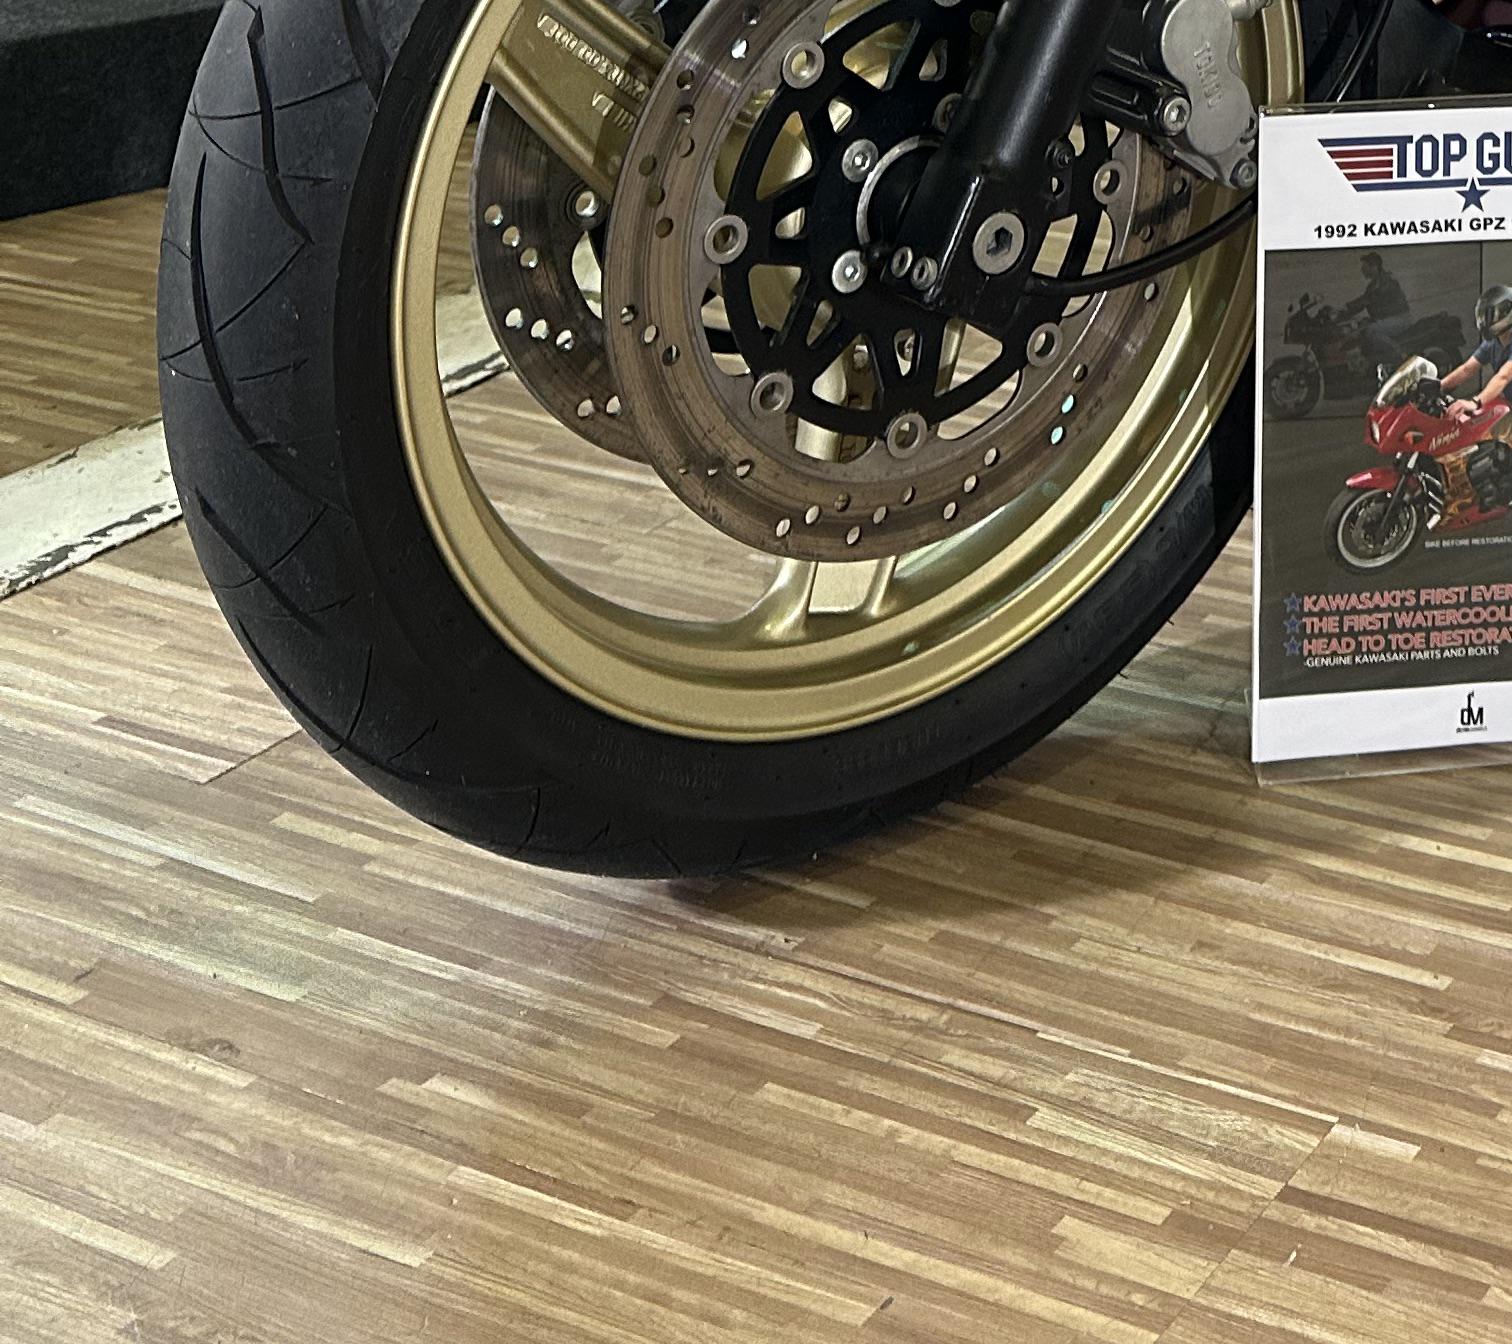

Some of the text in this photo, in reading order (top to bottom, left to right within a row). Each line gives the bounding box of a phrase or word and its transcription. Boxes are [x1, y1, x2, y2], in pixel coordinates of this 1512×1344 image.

[1394, 132, 1467, 179] TOP
[1314, 223, 1357, 240] 1992
[1363, 217, 1463, 237] KAWASAKI
[1469, 216, 1506, 232] GPZ
[1302, 588, 1416, 613] KAWASAKI'S
[1420, 585, 1469, 607] FIRST
[1302, 615, 1340, 634] THE
[1343, 612, 1393, 633] FIRST
[1302, 637, 1356, 657] HEAD
[1358, 634, 1386, 652] TO
[1388, 631, 1427, 650] TOE
[1354, 651, 1409, 665] KAWASAKI
[1410, 649, 1441, 661] PARTS
[1443, 647, 1466, 659] AND
[1467, 645, 1500, 657] BOLTS
